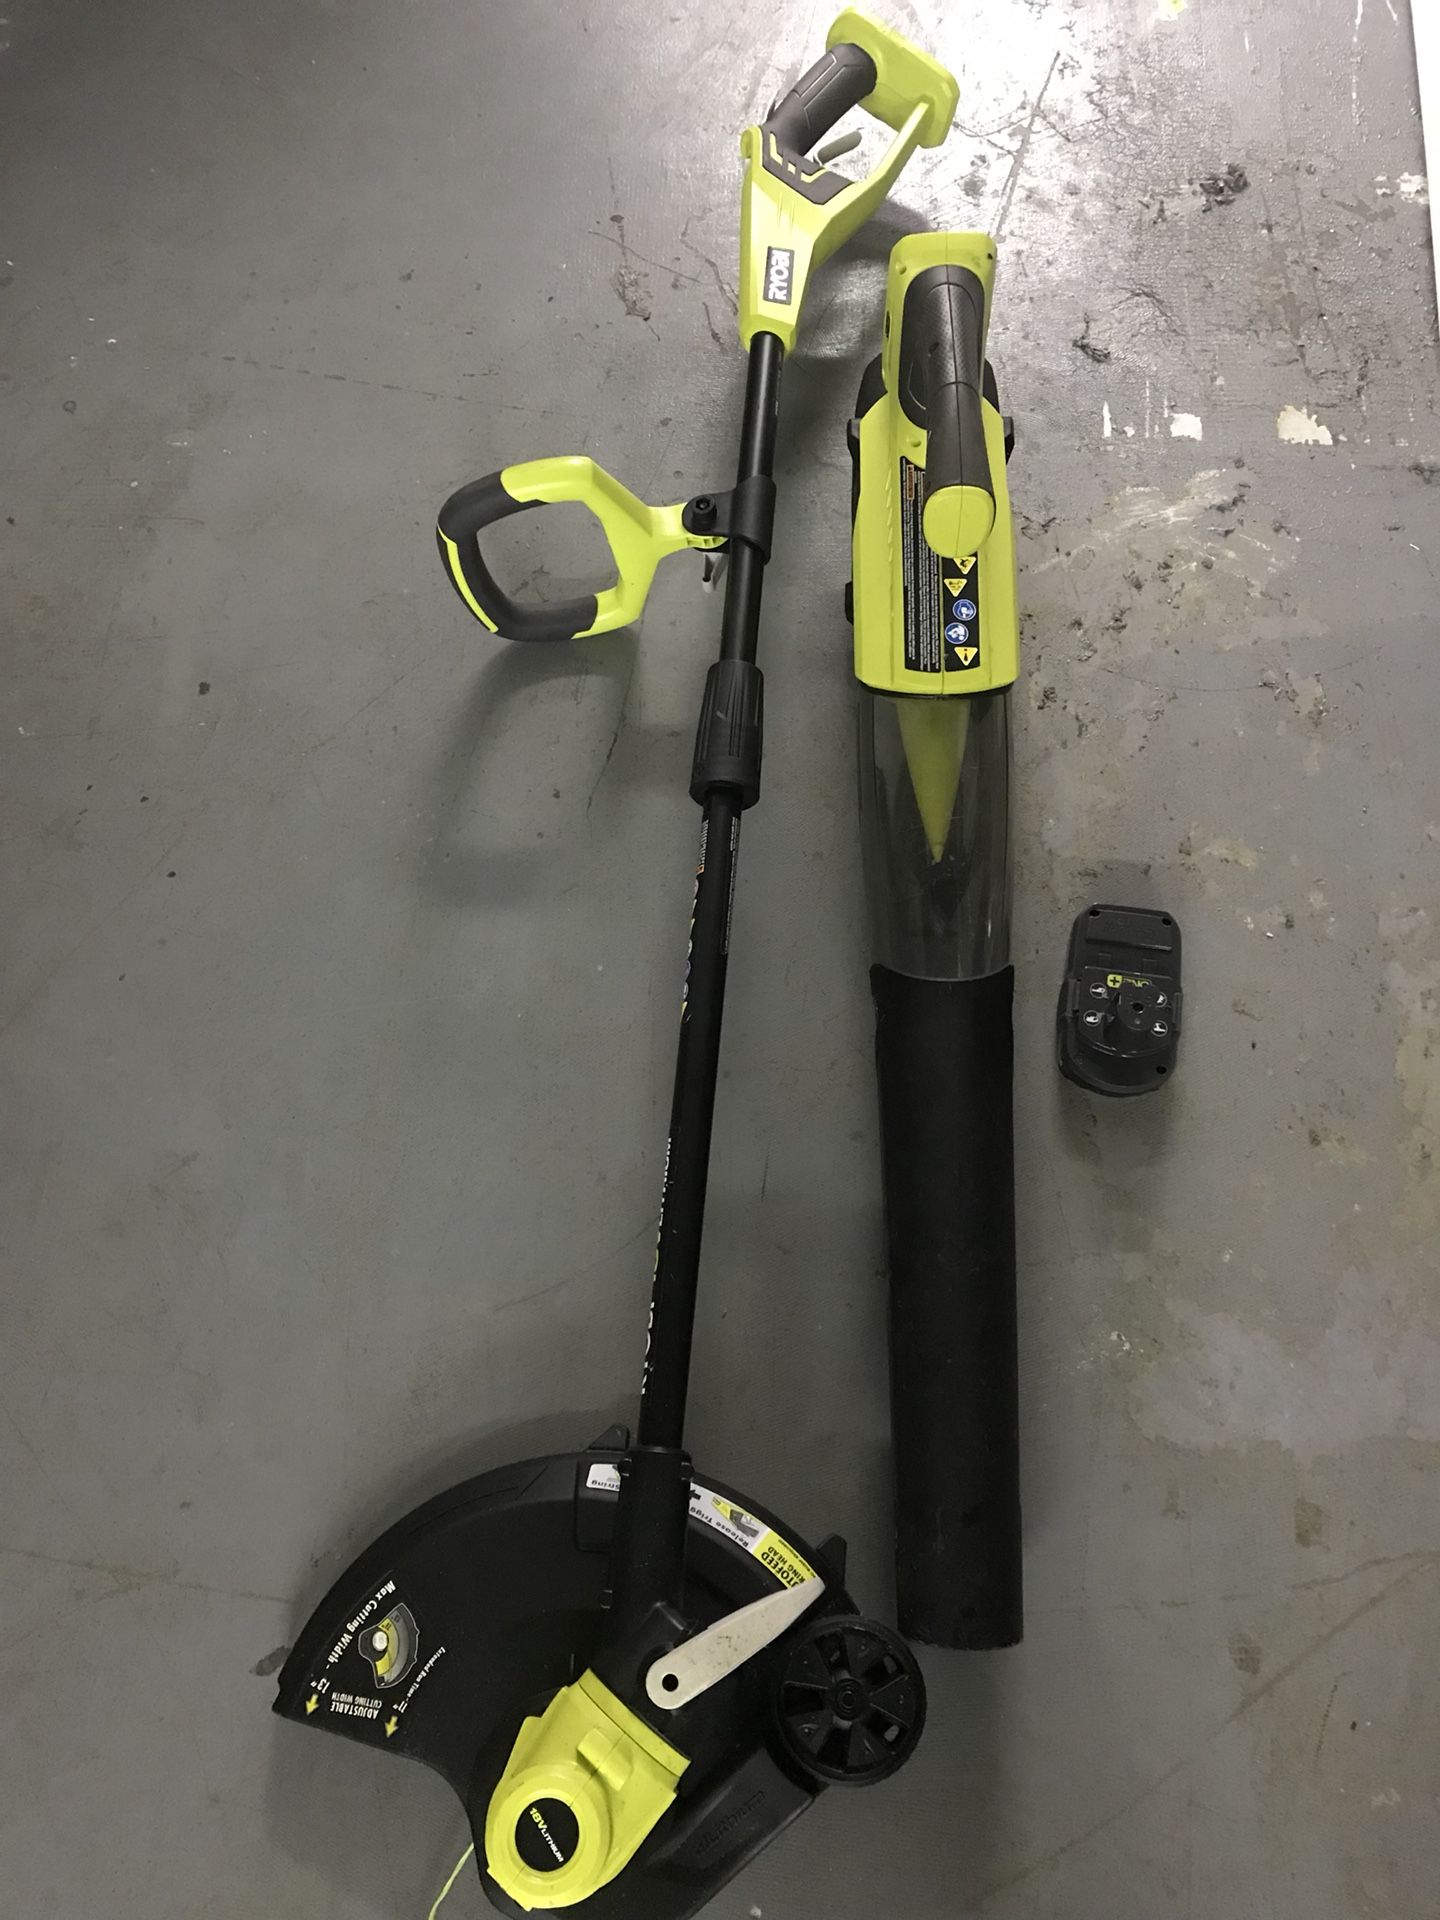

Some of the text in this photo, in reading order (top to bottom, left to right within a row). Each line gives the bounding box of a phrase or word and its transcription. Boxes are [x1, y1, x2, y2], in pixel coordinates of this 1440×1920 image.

[768, 249, 790, 300] RYOBI
[689, 1506, 749, 1548] Release Trigg
[767, 1546, 788, 1566] HEAD
[787, 1564, 806, 1585] RING
[375, 1580, 397, 1601] Max
[346, 1600, 378, 1633] Cutting
[327, 1633, 353, 1664] Width
[423, 1646, 446, 1673] Extended
[416, 1670, 427, 1682] Run
[332, 1692, 382, 1709] CUTTING WIDTH
[407, 1682, 420, 1698] Time
[330, 1701, 380, 1719] ADJUSTABLE
